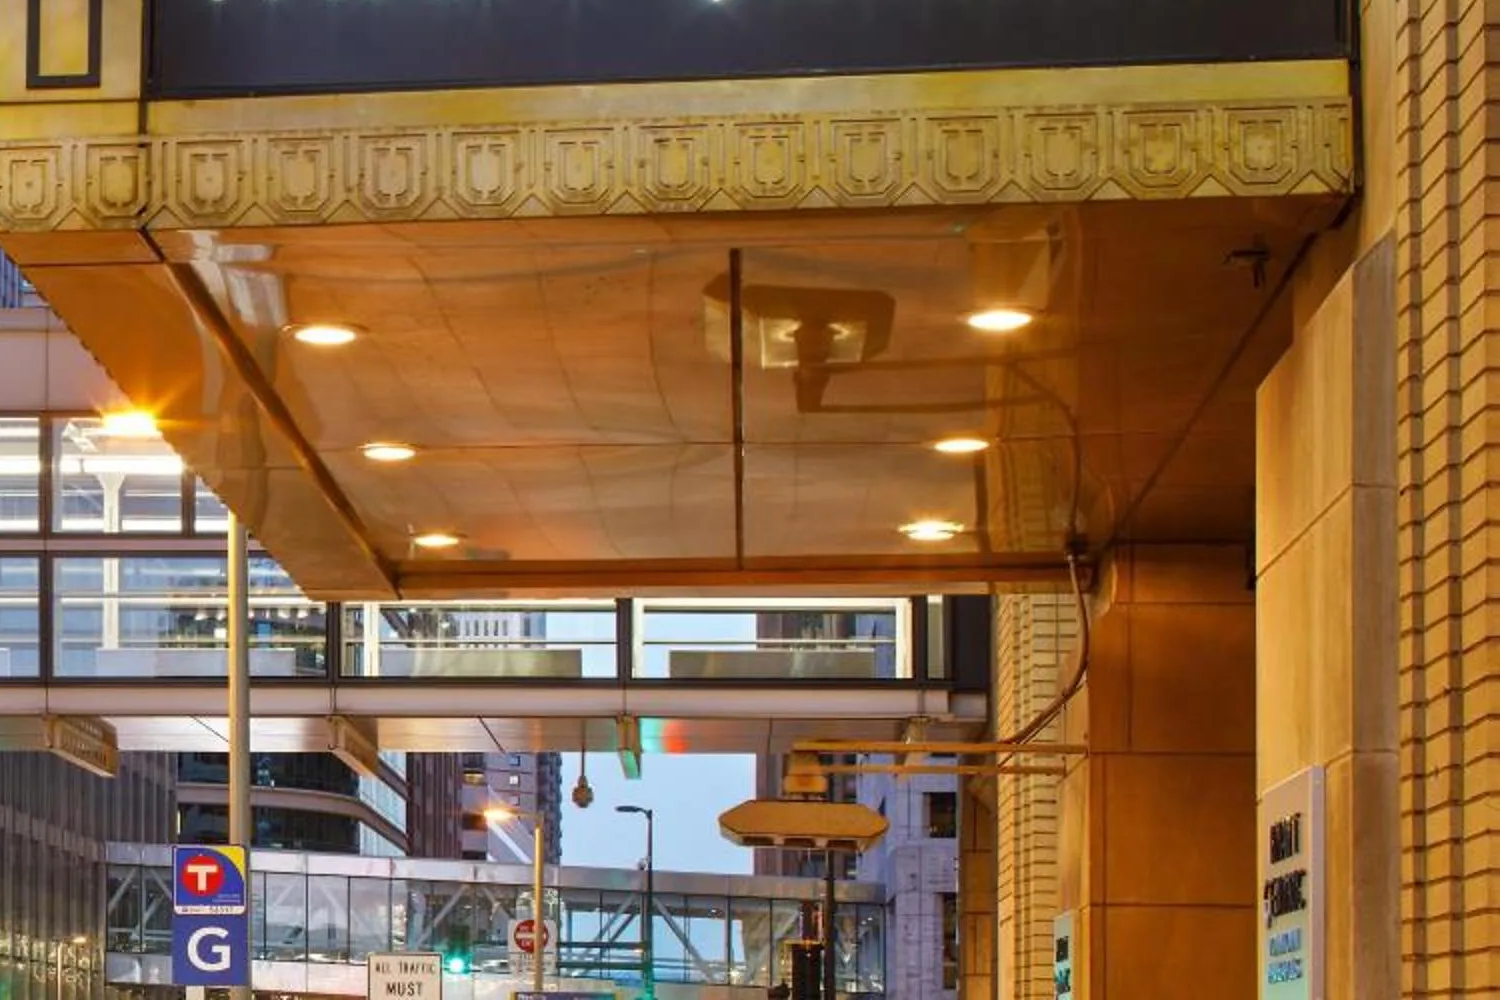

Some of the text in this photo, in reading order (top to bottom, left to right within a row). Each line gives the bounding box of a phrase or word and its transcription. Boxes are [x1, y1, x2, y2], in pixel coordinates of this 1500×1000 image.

[187, 864, 218, 892] T
[187, 926, 231, 972] G
[375, 960, 437, 976] ALL TRAFFIC
[386, 981, 424, 997] MUST
